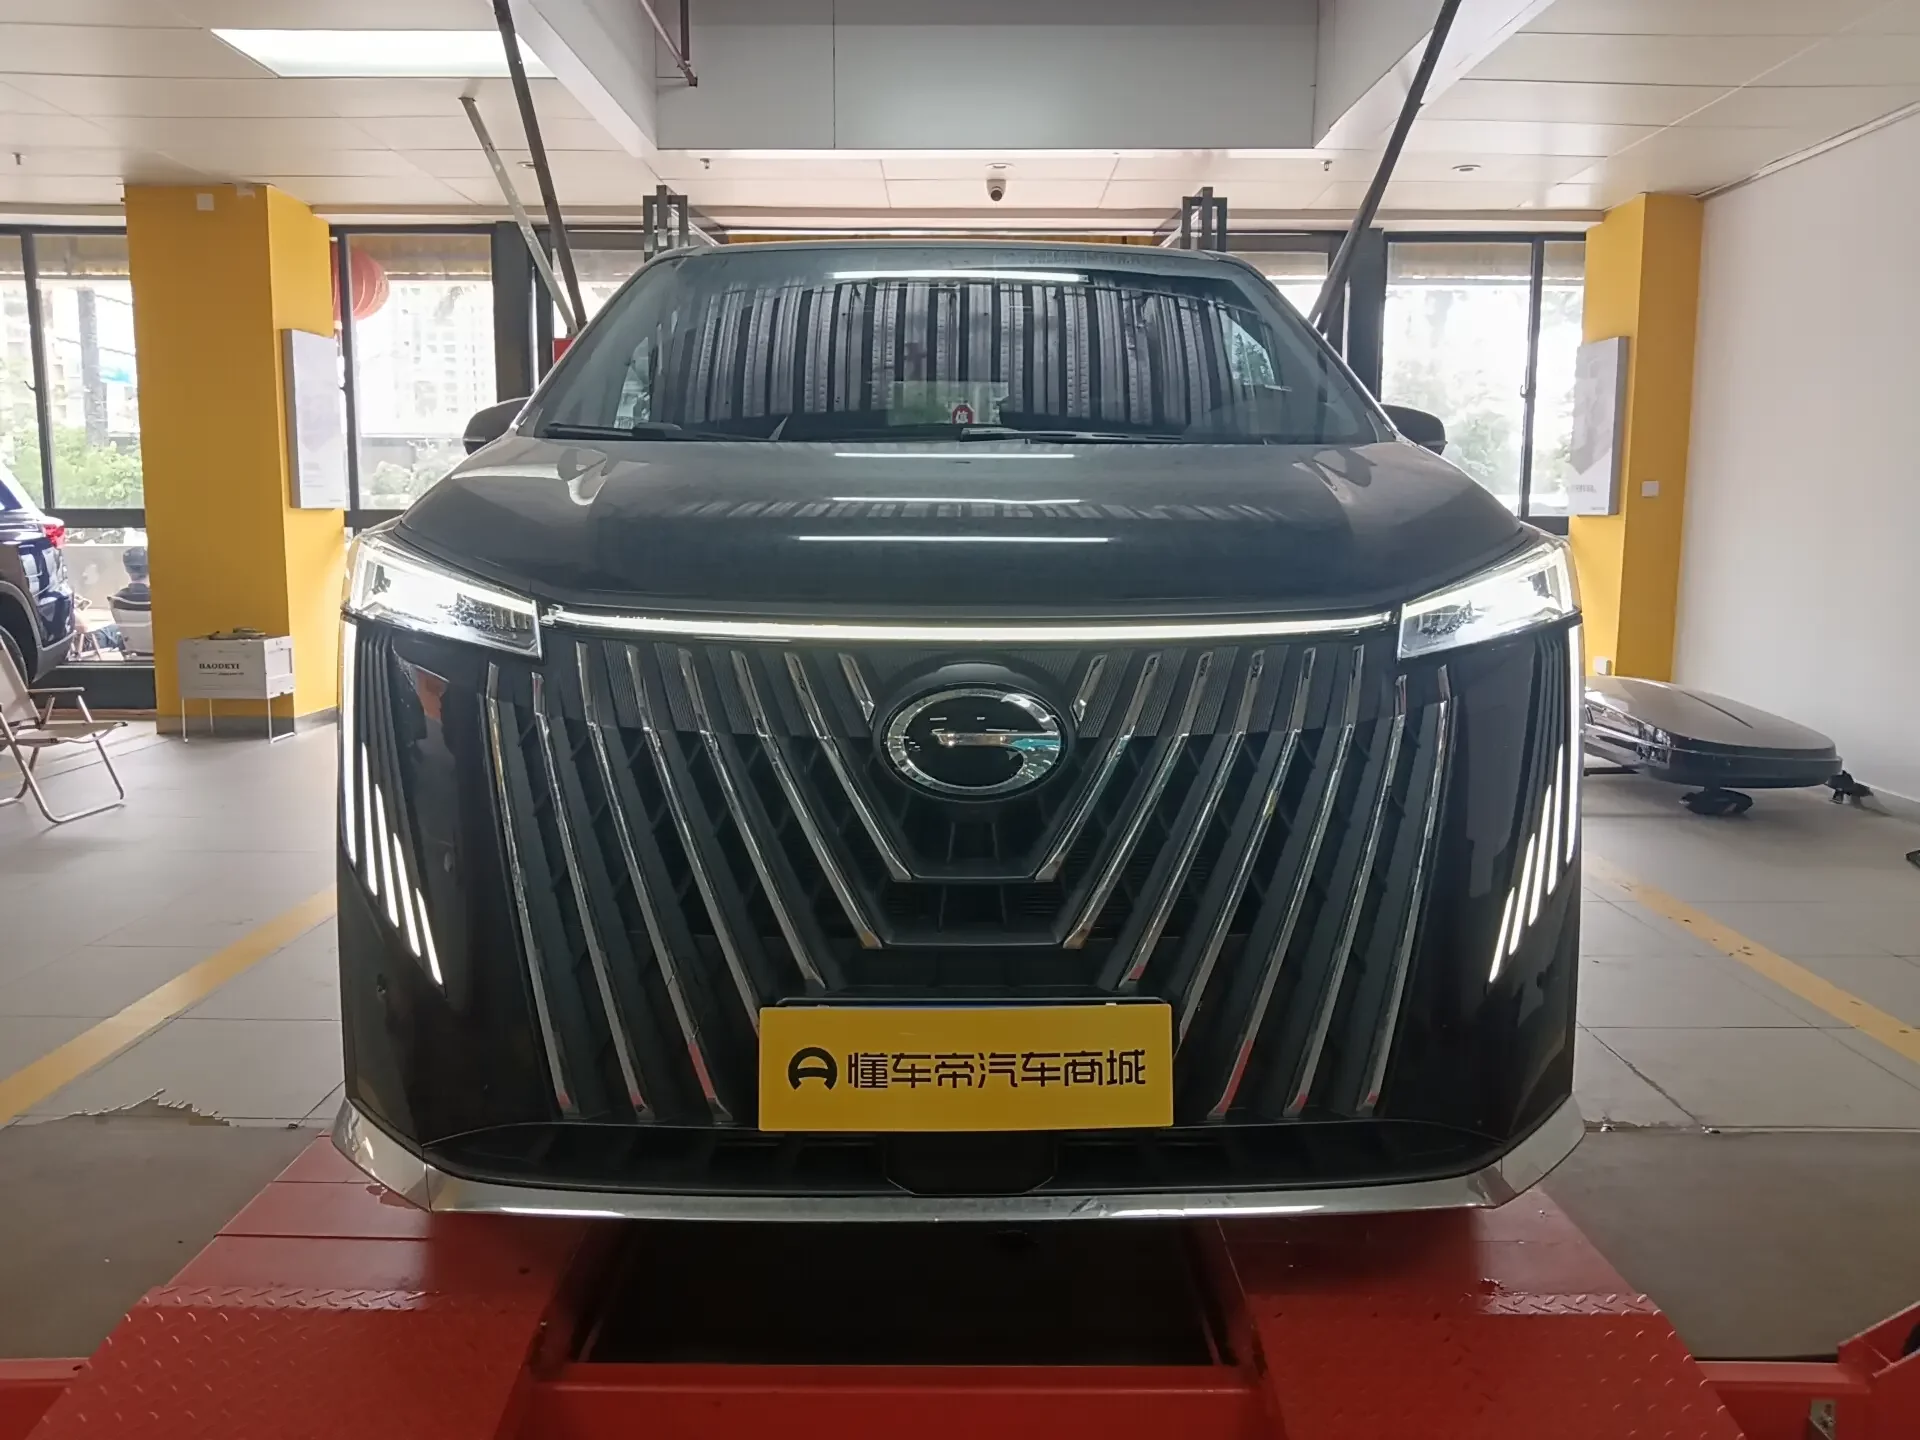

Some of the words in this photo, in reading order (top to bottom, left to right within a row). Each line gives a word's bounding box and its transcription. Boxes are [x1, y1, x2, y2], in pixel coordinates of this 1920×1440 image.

[847, 1049, 1146, 1089] 懂车帝汽车商城
